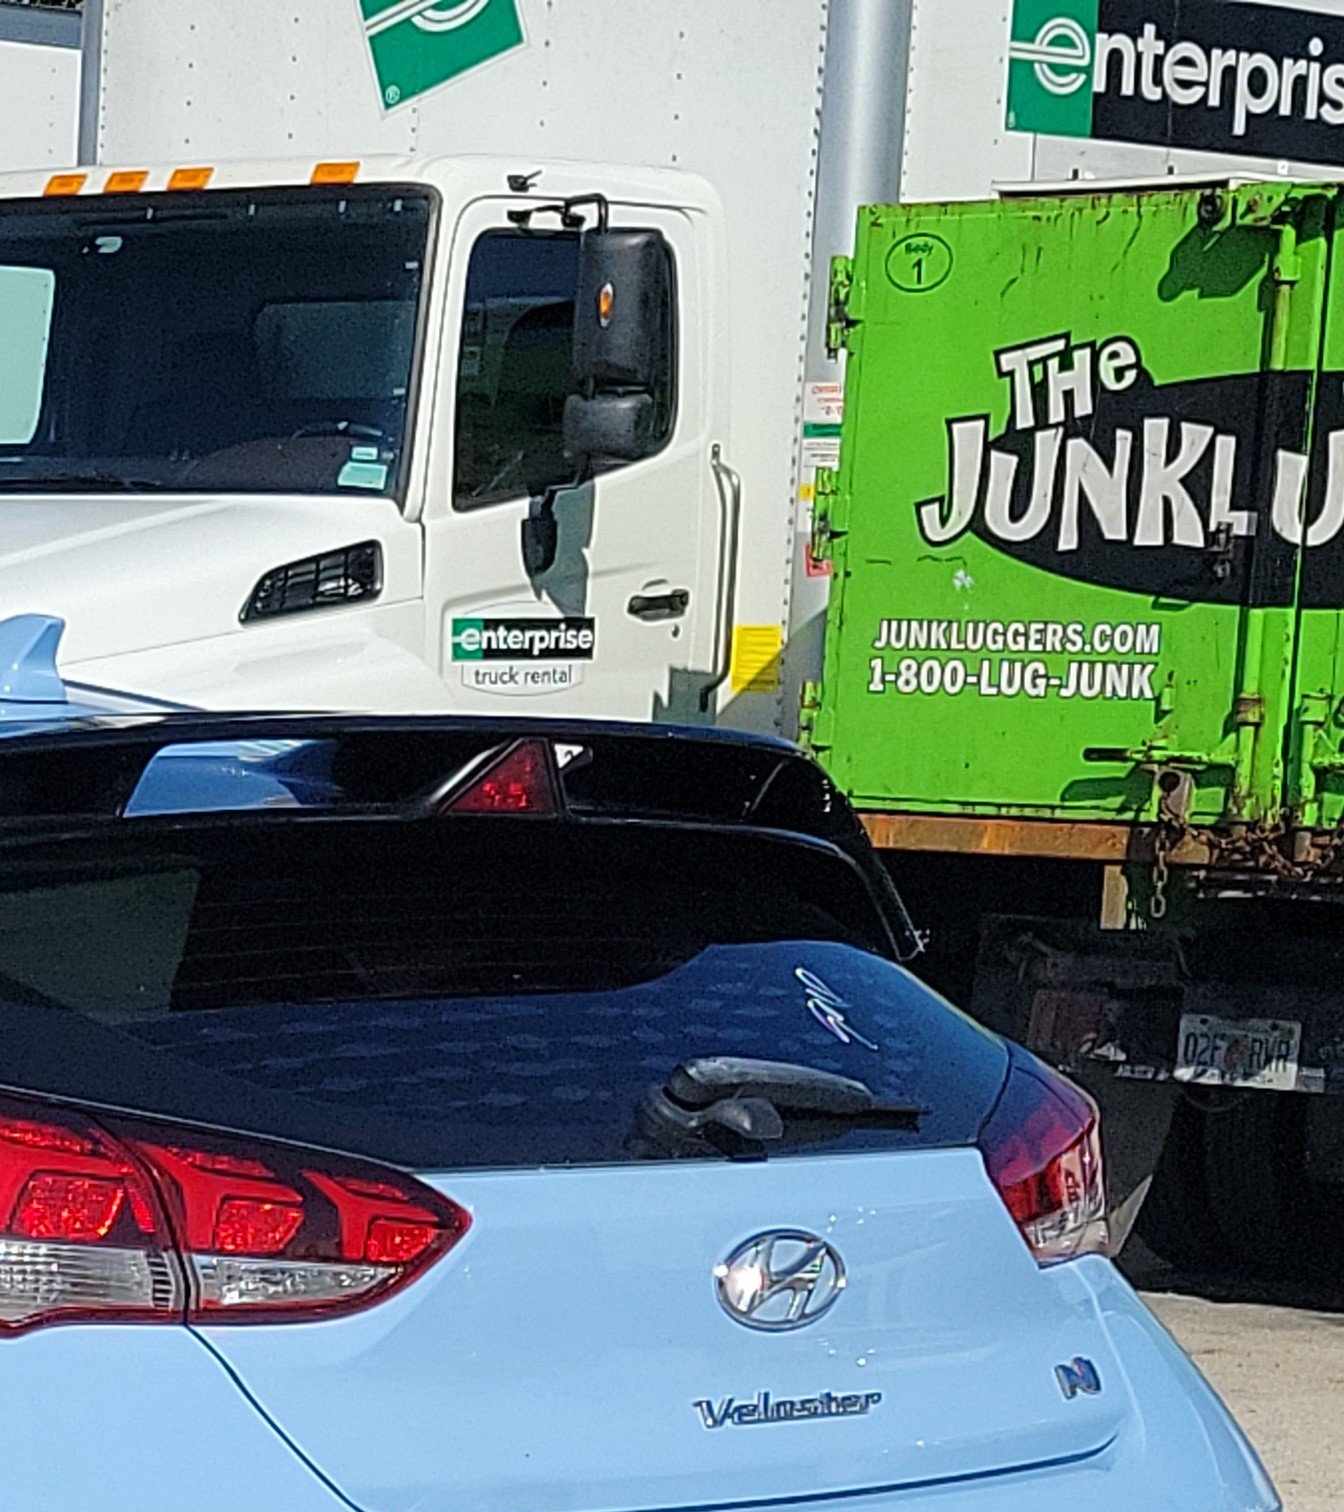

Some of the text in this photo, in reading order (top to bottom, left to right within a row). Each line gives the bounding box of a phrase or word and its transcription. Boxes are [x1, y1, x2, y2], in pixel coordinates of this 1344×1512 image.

[1012, 17, 1344, 136] enterpris
[912, 258, 922, 285] 1
[454, 622, 594, 656] enterprise
[873, 618, 1161, 655] JUNKLUGGERS.COM
[474, 664, 572, 685] truck rental
[867, 657, 1157, 700] 1-800-LUG-JUNK
[693, 1390, 883, 1429] Veloster
